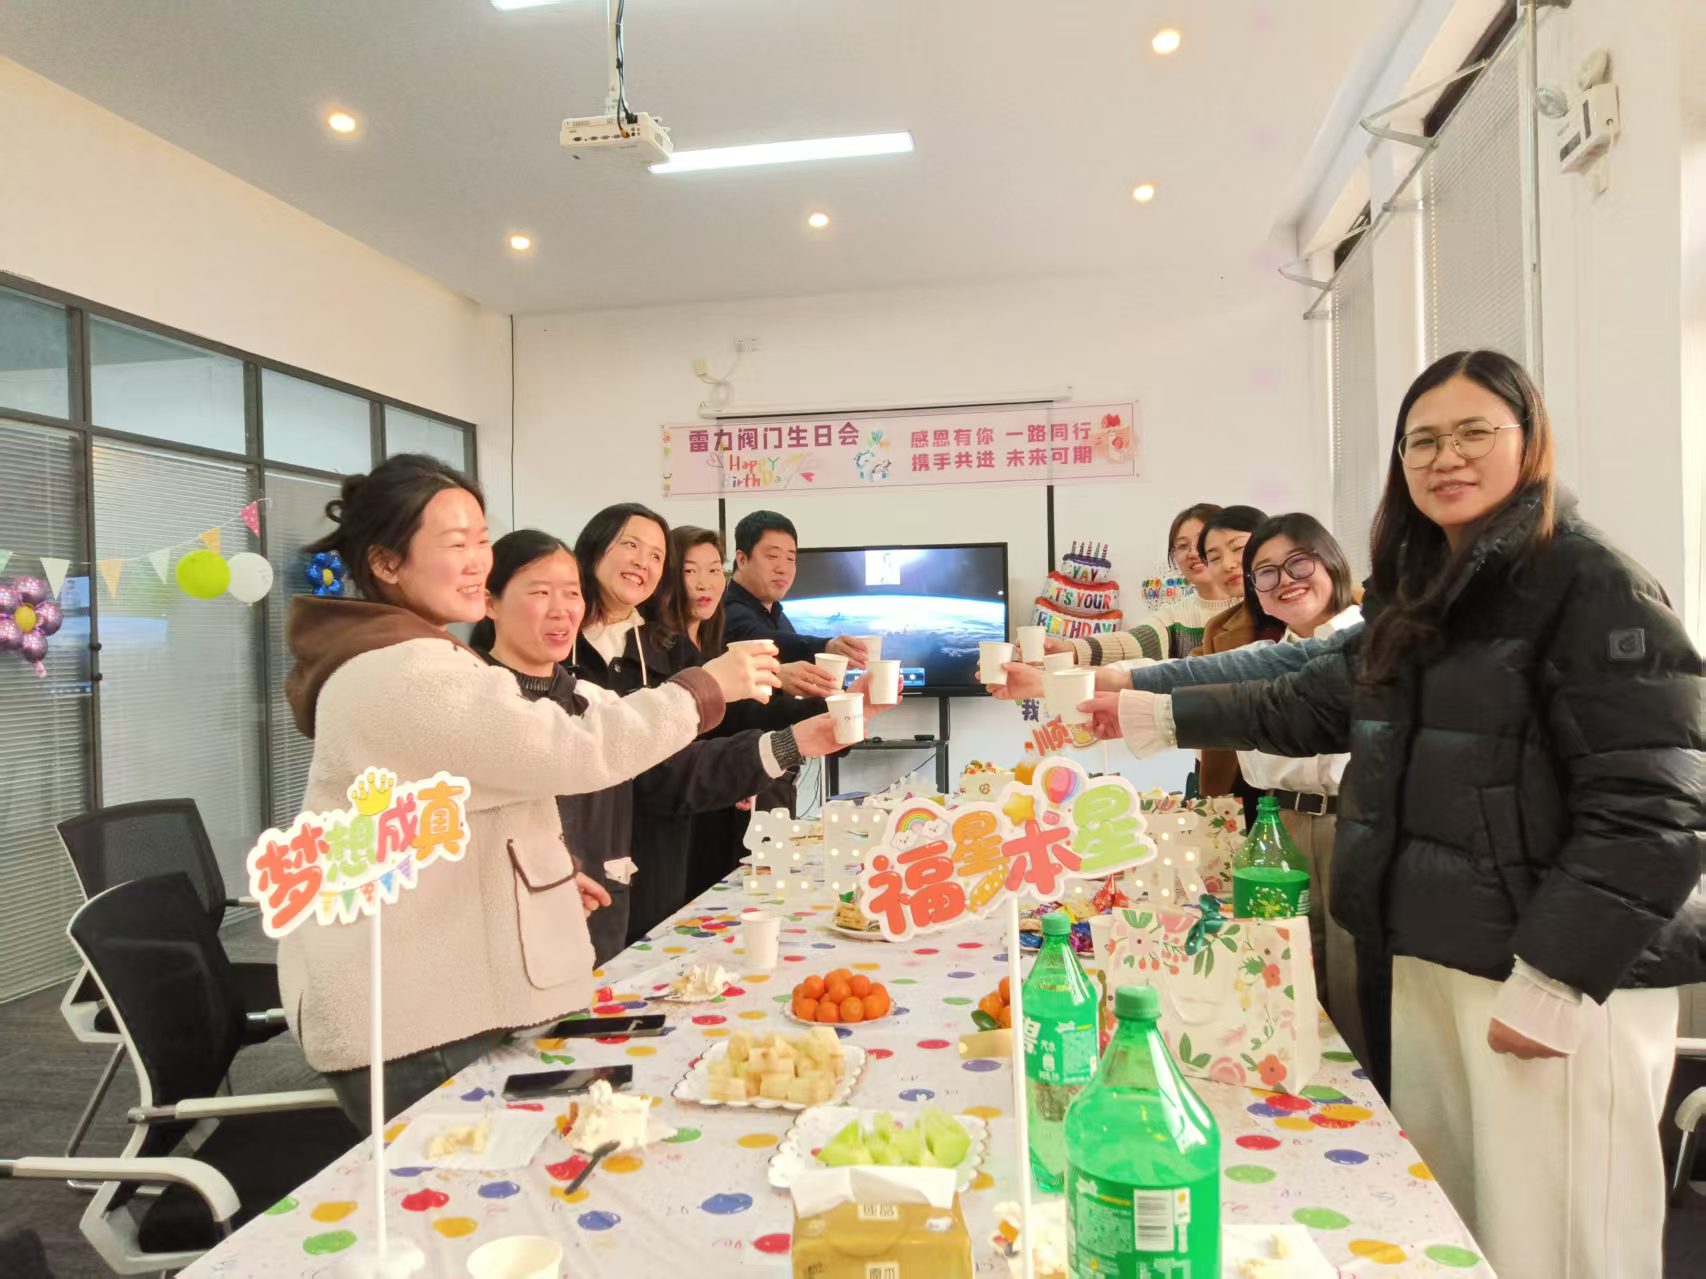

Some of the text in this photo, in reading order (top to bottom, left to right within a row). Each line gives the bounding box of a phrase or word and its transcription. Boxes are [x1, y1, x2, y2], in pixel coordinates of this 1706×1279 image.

[689, 421, 859, 452] 雷力阀门生日会
[911, 422, 1091, 448] 感恩有你 一路同行
[912, 446, 1093, 472] 携手共进 未来可期
[1071, 566, 1098, 580] YAY
[1076, 592, 1111, 611] YOUR
[1036, 611, 1117, 639] BIRTHDAY!
[255, 780, 465, 929] 梦想成真
[868, 784, 1151, 935] 福星本星
